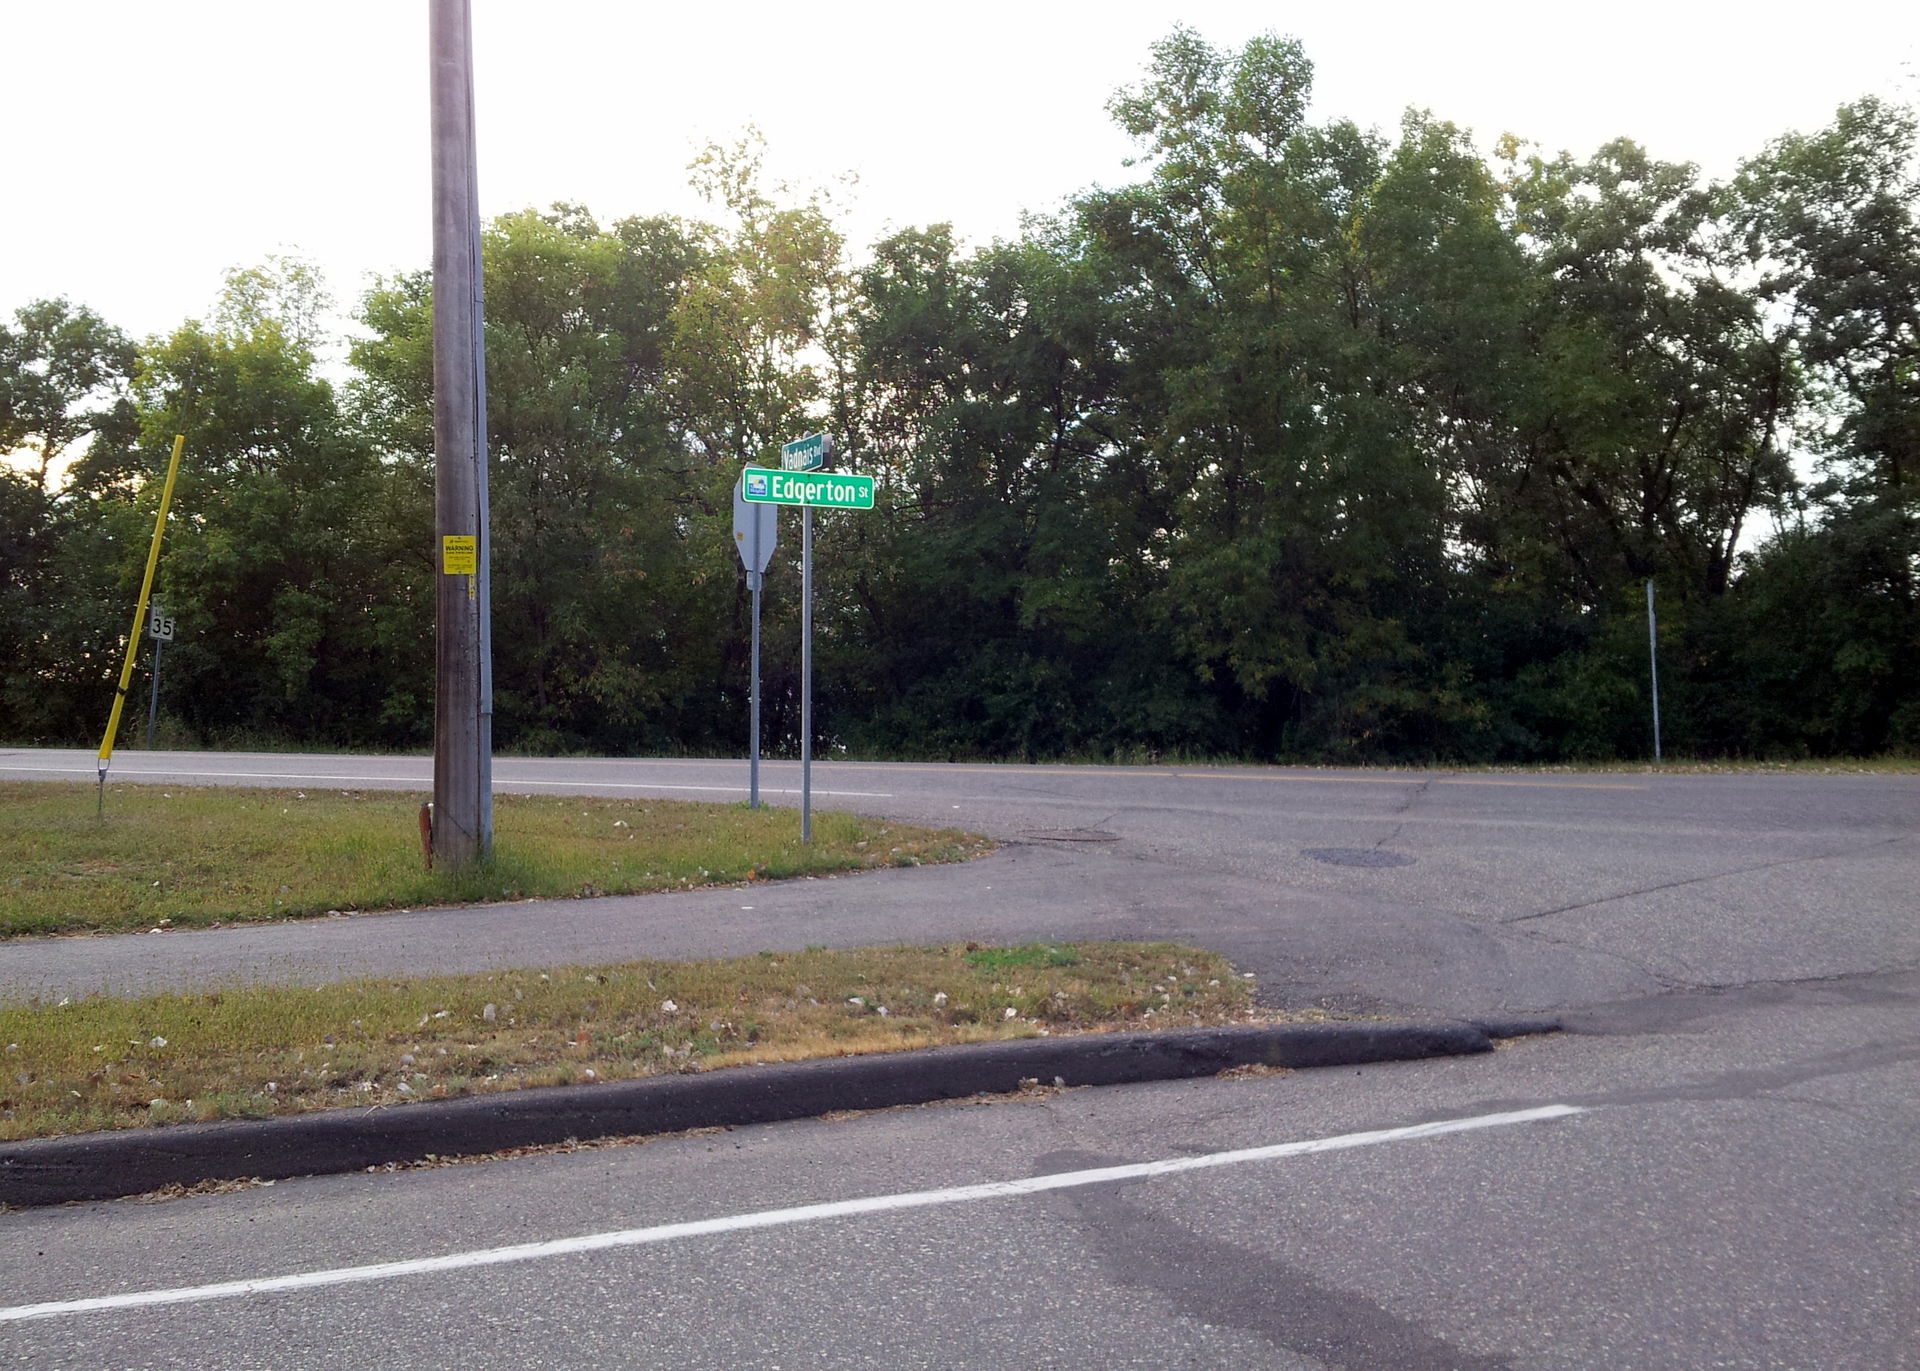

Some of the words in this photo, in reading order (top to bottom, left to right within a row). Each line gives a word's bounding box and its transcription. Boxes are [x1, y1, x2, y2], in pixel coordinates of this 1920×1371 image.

[784, 444, 813, 471] Vadnais
[773, 476, 856, 504] Edgerton
[858, 486, 869, 498] St
[152, 618, 172, 635] 35
